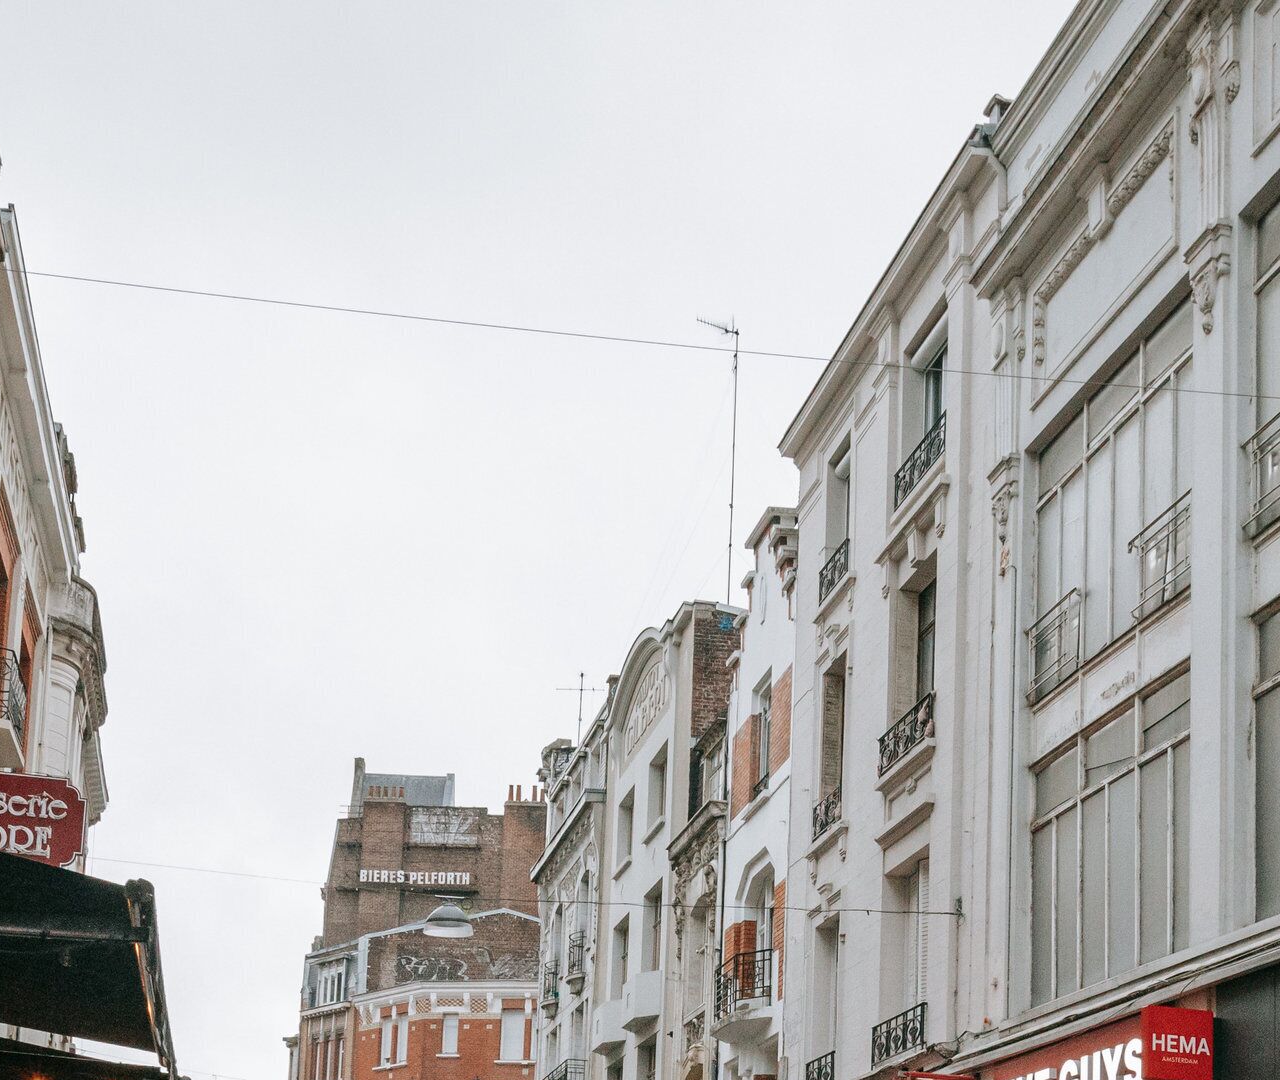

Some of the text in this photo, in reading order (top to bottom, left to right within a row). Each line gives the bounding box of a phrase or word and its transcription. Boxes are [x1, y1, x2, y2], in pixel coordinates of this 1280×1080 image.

[360, 869, 470, 885] BIERES PELFORTH
[1151, 1033, 1211, 1056] HEMA
[1161, 1057, 1199, 1065] AMSTERDAM
